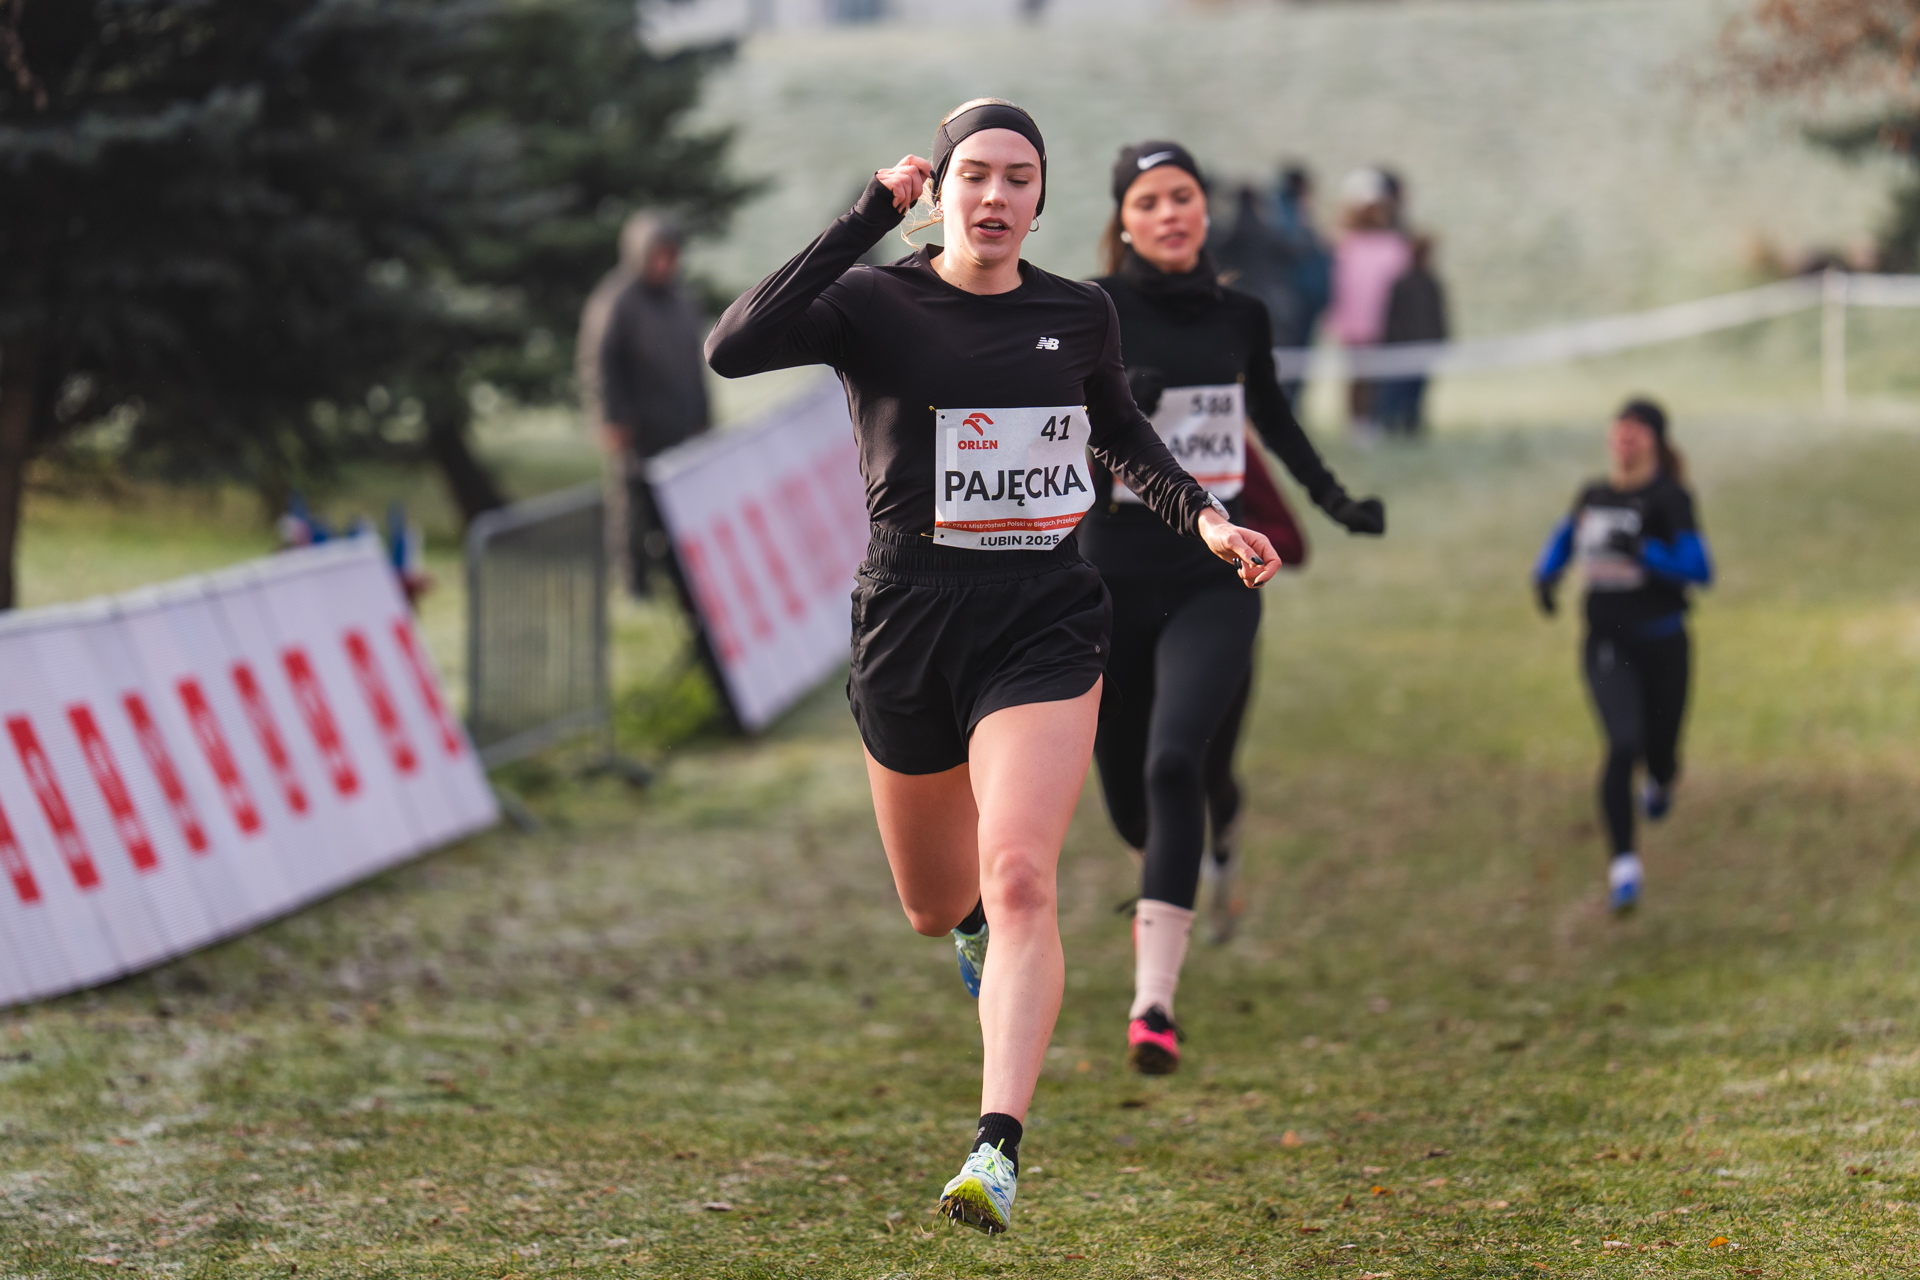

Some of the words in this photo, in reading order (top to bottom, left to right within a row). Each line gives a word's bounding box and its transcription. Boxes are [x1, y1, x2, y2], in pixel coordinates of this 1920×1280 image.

[1040, 415, 1071, 442] 41
[957, 439, 999, 450] ORLEN
[1168, 433, 1236, 458] APKA
[944, 463, 1088, 507] PAJĘCKA
[968, 521, 1006, 529] Mistrzostwa
[1033, 519, 1056, 529] Biegach
[980, 535, 1022, 546] LUBIN
[1025, 534, 1060, 546] 2025
